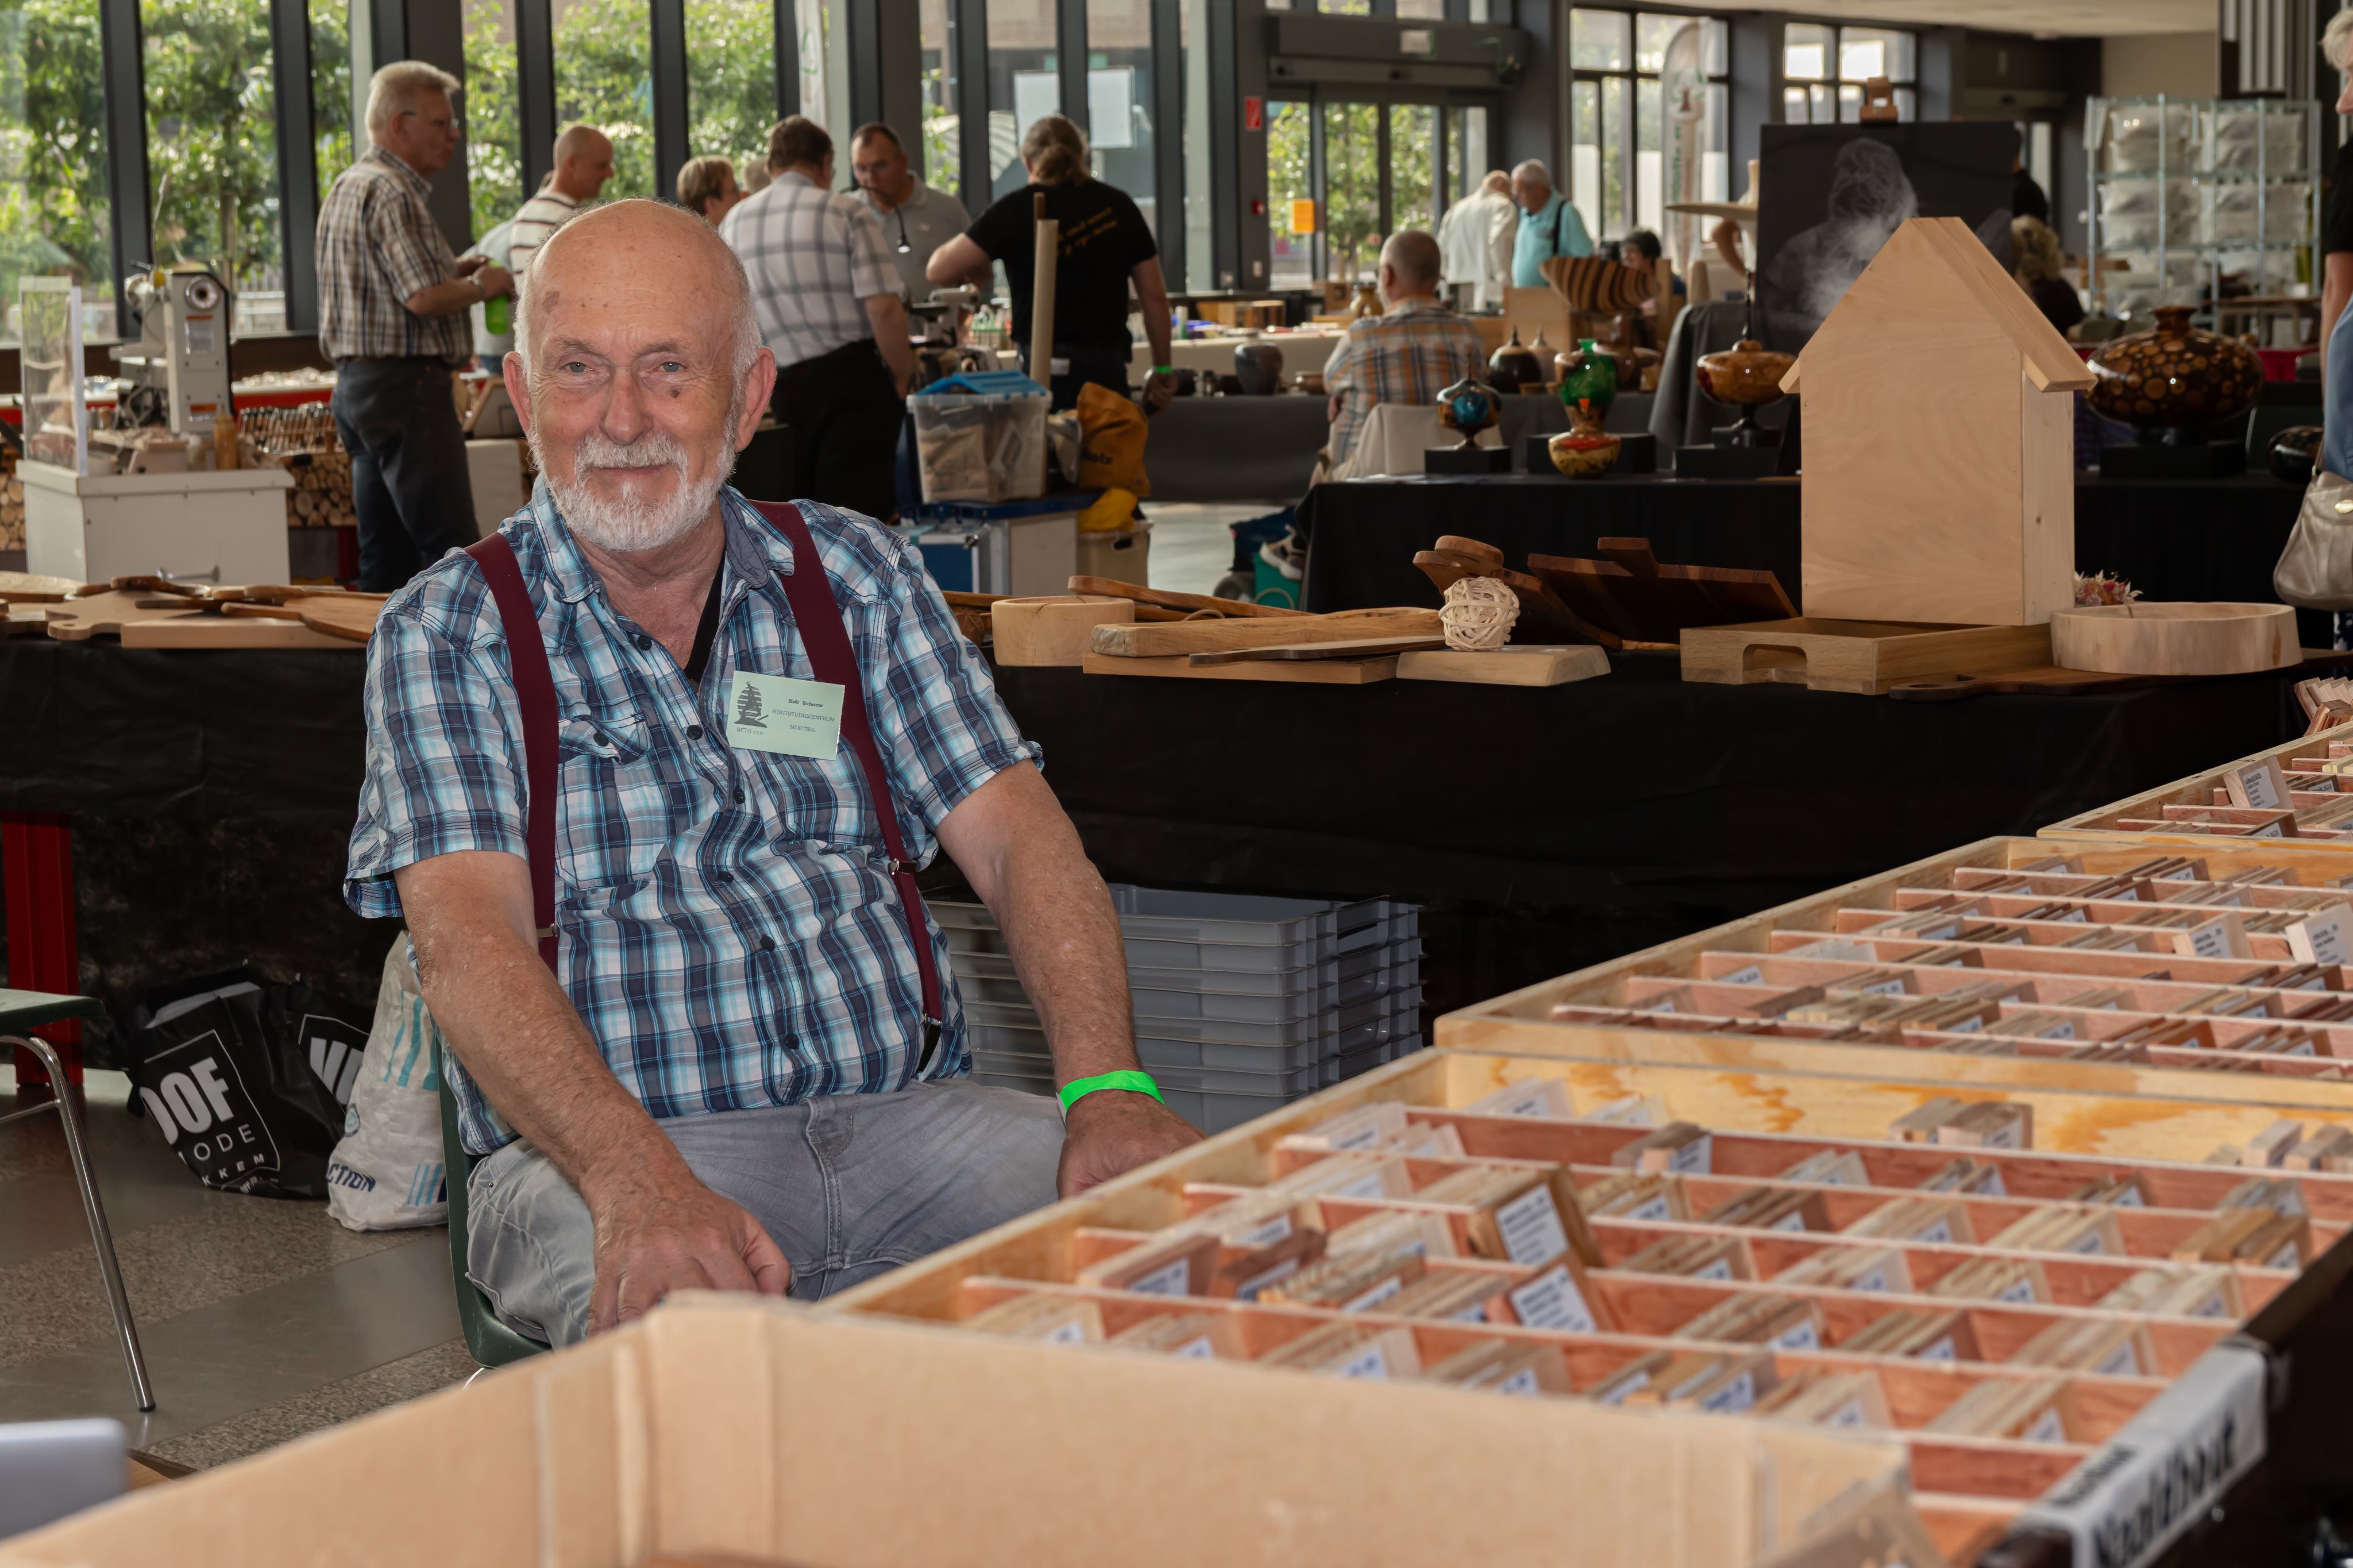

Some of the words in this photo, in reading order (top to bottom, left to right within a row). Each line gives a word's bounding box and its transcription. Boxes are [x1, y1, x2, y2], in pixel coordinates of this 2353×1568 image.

[772, 709, 835, 722] HOUTSTUDIECENTRUM
[789, 724, 816, 732] MORTSEL
[178, 1123, 256, 1165] ODE
